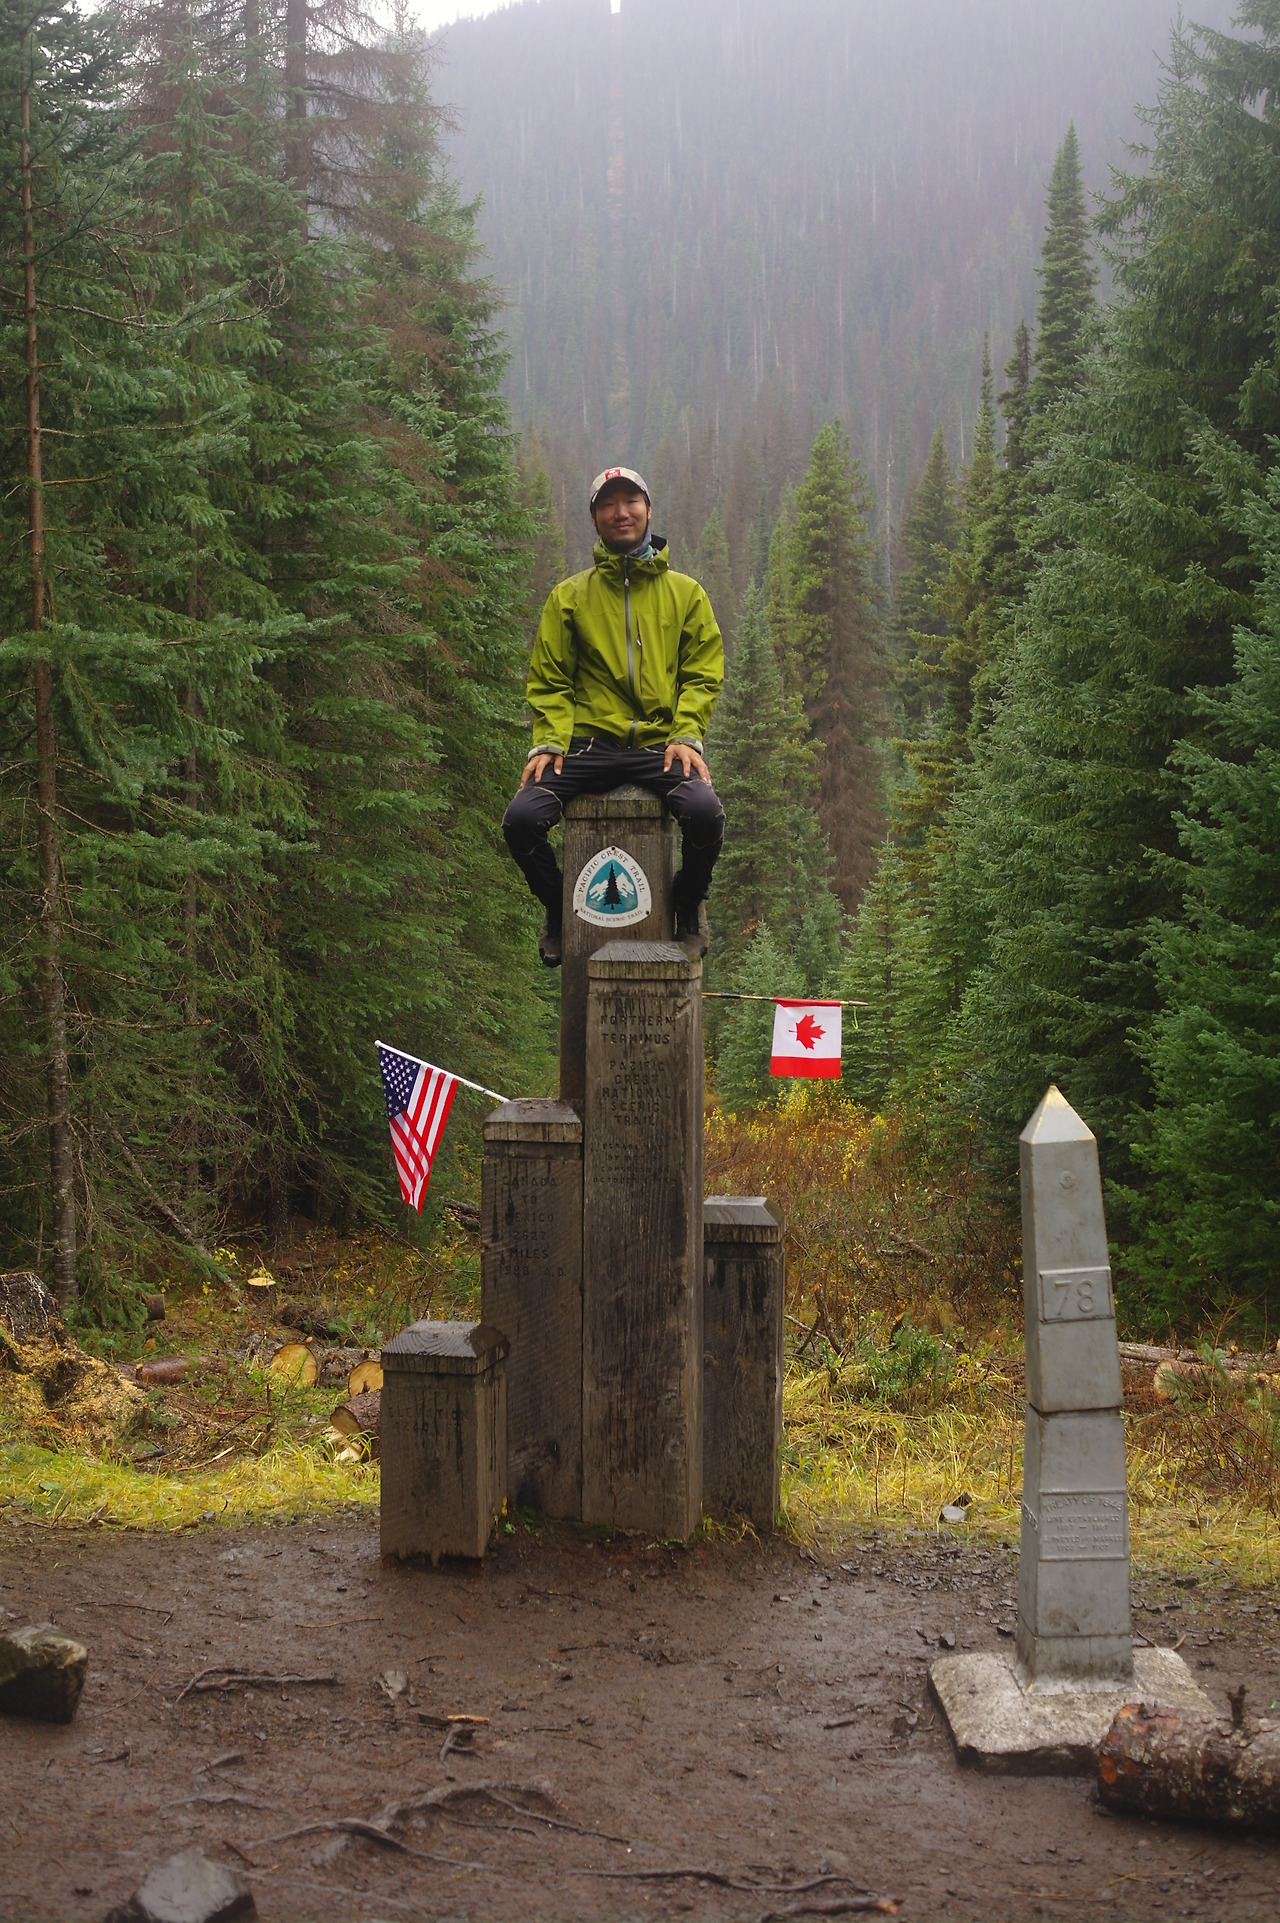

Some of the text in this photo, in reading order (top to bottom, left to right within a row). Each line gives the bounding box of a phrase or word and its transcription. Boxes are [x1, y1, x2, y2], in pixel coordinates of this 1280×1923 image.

[578, 850, 645, 893] PACIFIC CREST TRAIL
[580, 908, 604, 921] NATIONAL
[628, 910, 643, 920] TRAIL
[600, 1015, 675, 1026] NORTHERN
[601, 1033, 670, 1045] TERMINUS
[609, 1061, 665, 1072] PACIFIC
[614, 1074, 658, 1085] CREST
[602, 1087, 671, 1099] NATIONAL
[610, 1102, 660, 1112] SCENIC
[614, 1115, 655, 1126] TRAIL
[502, 1176, 557, 1188] CANADA
[521, 1195, 537, 1205] TO
[505, 1213, 554, 1223] EXICO
[513, 1231, 546, 1241] 2627
[510, 1249, 549, 1260] MILES
[1054, 1280, 1097, 1316] 78
[1042, 1495, 1080, 1512] TREATY
[1082, 1495, 1096, 1505] OF
